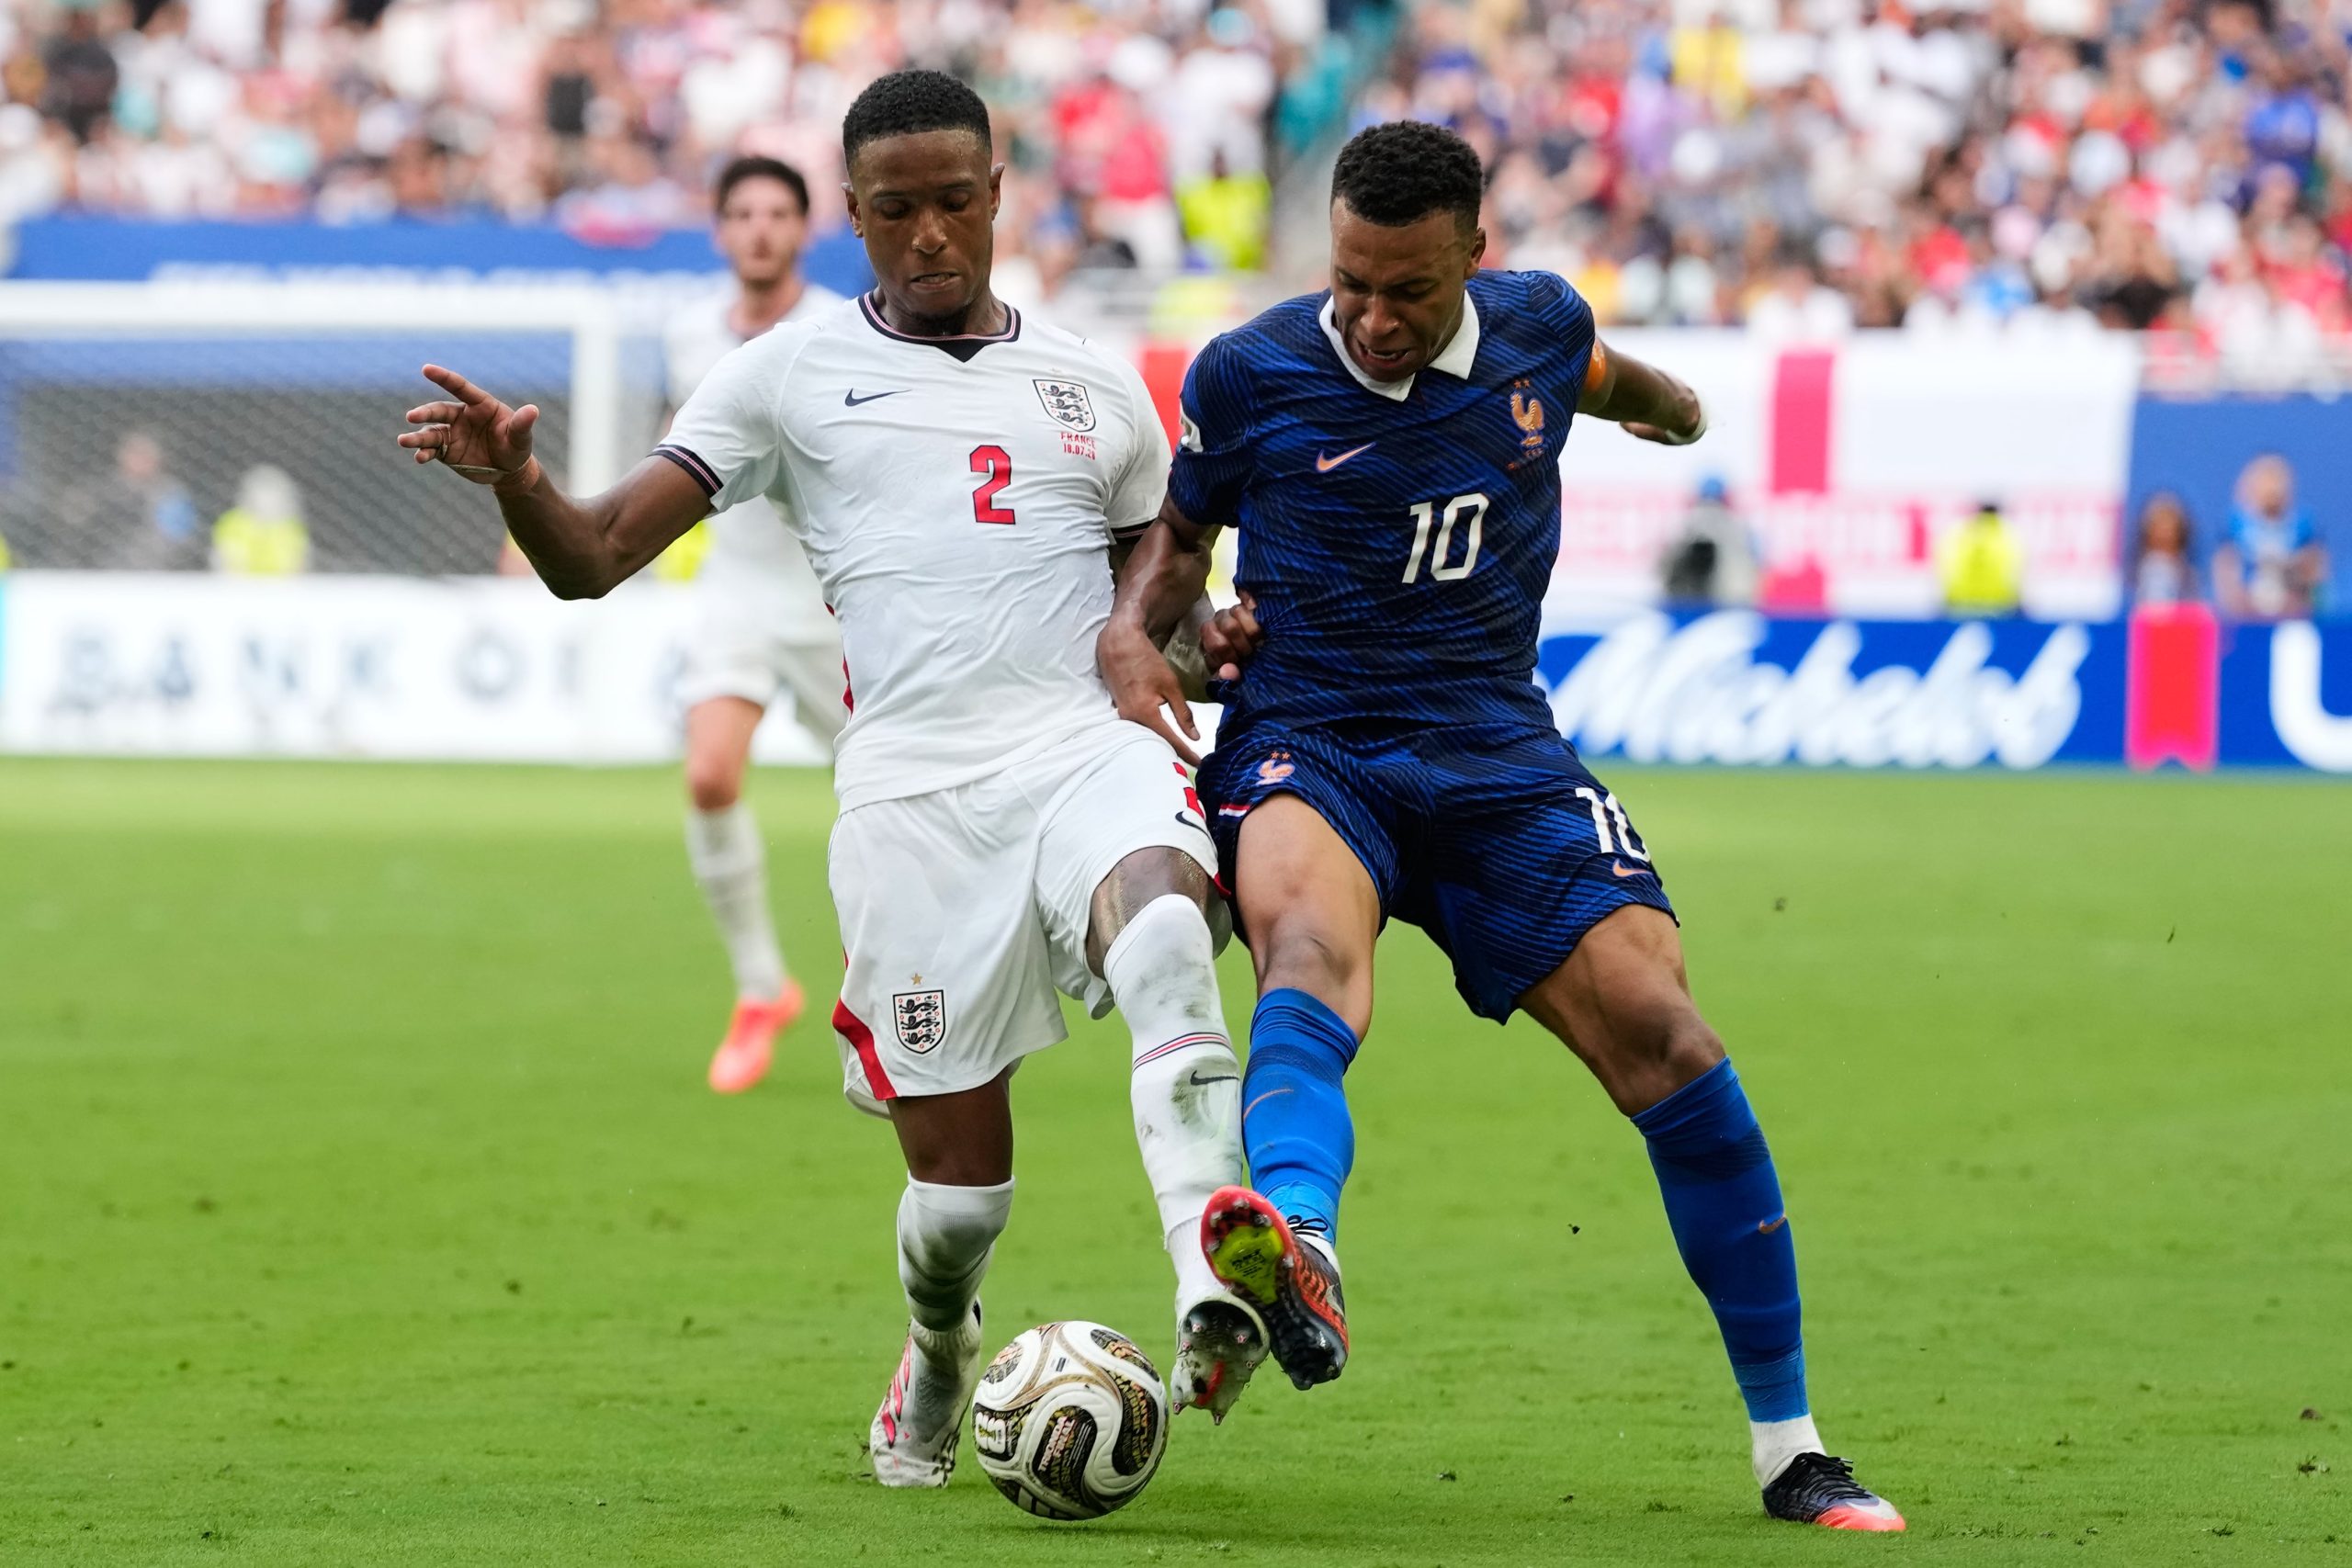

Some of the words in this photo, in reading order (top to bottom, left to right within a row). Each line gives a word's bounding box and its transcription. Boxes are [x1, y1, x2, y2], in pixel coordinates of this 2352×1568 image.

[1060, 432, 1095, 449] FRANCE
[969, 445, 1016, 525] 2
[1401, 492, 1490, 584] 10
[1575, 787, 1651, 863] 10
[1037, 1416, 1069, 1471] TRIONDA
[1052, 1418, 1077, 1458] FINAL
